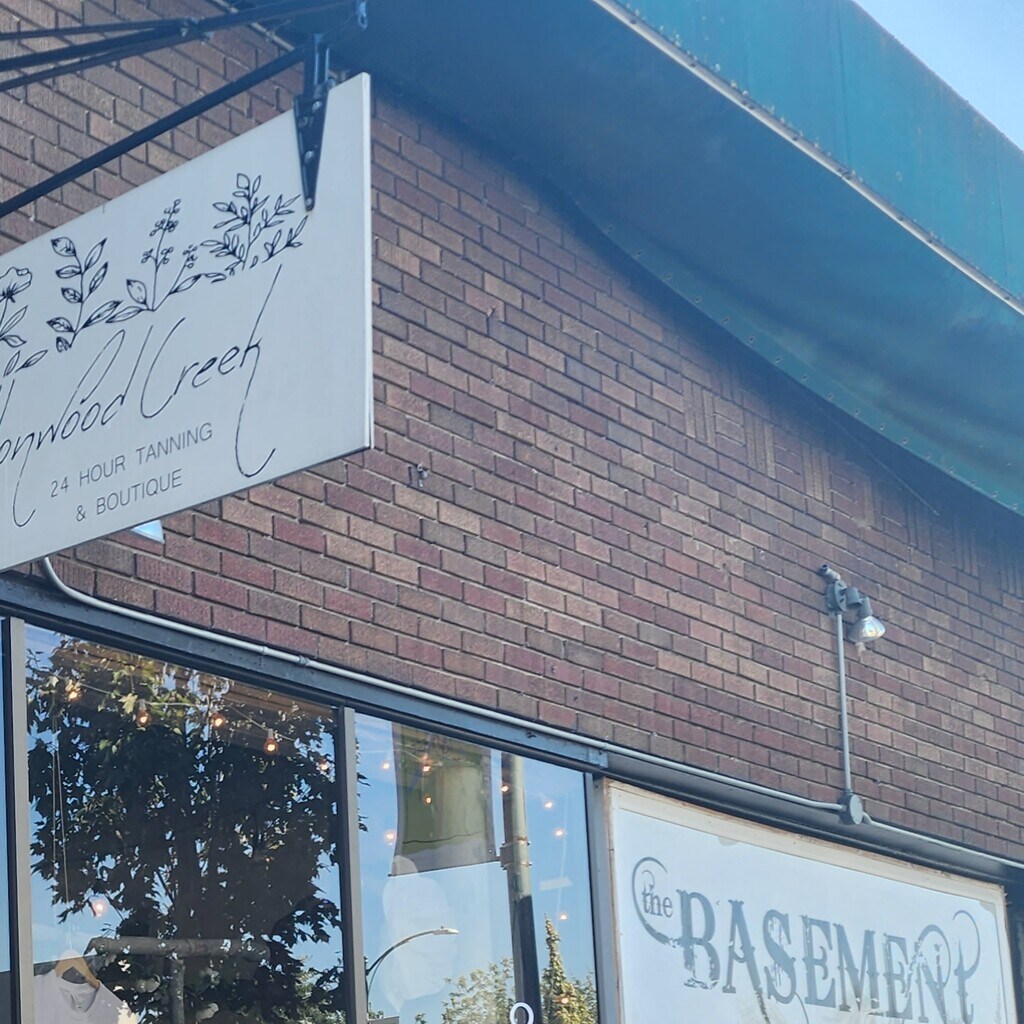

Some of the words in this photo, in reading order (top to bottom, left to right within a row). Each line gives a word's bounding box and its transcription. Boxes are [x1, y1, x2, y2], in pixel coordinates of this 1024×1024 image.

[140, 264, 282, 478] Creek
[50, 479, 68, 498] 24
[79, 454, 127, 486] HOUR
[135, 421, 214, 463] TANNING
[76, 504, 87, 522] &
[96, 471, 184, 514] BOUTIQUE
[641, 870, 674, 919] the
